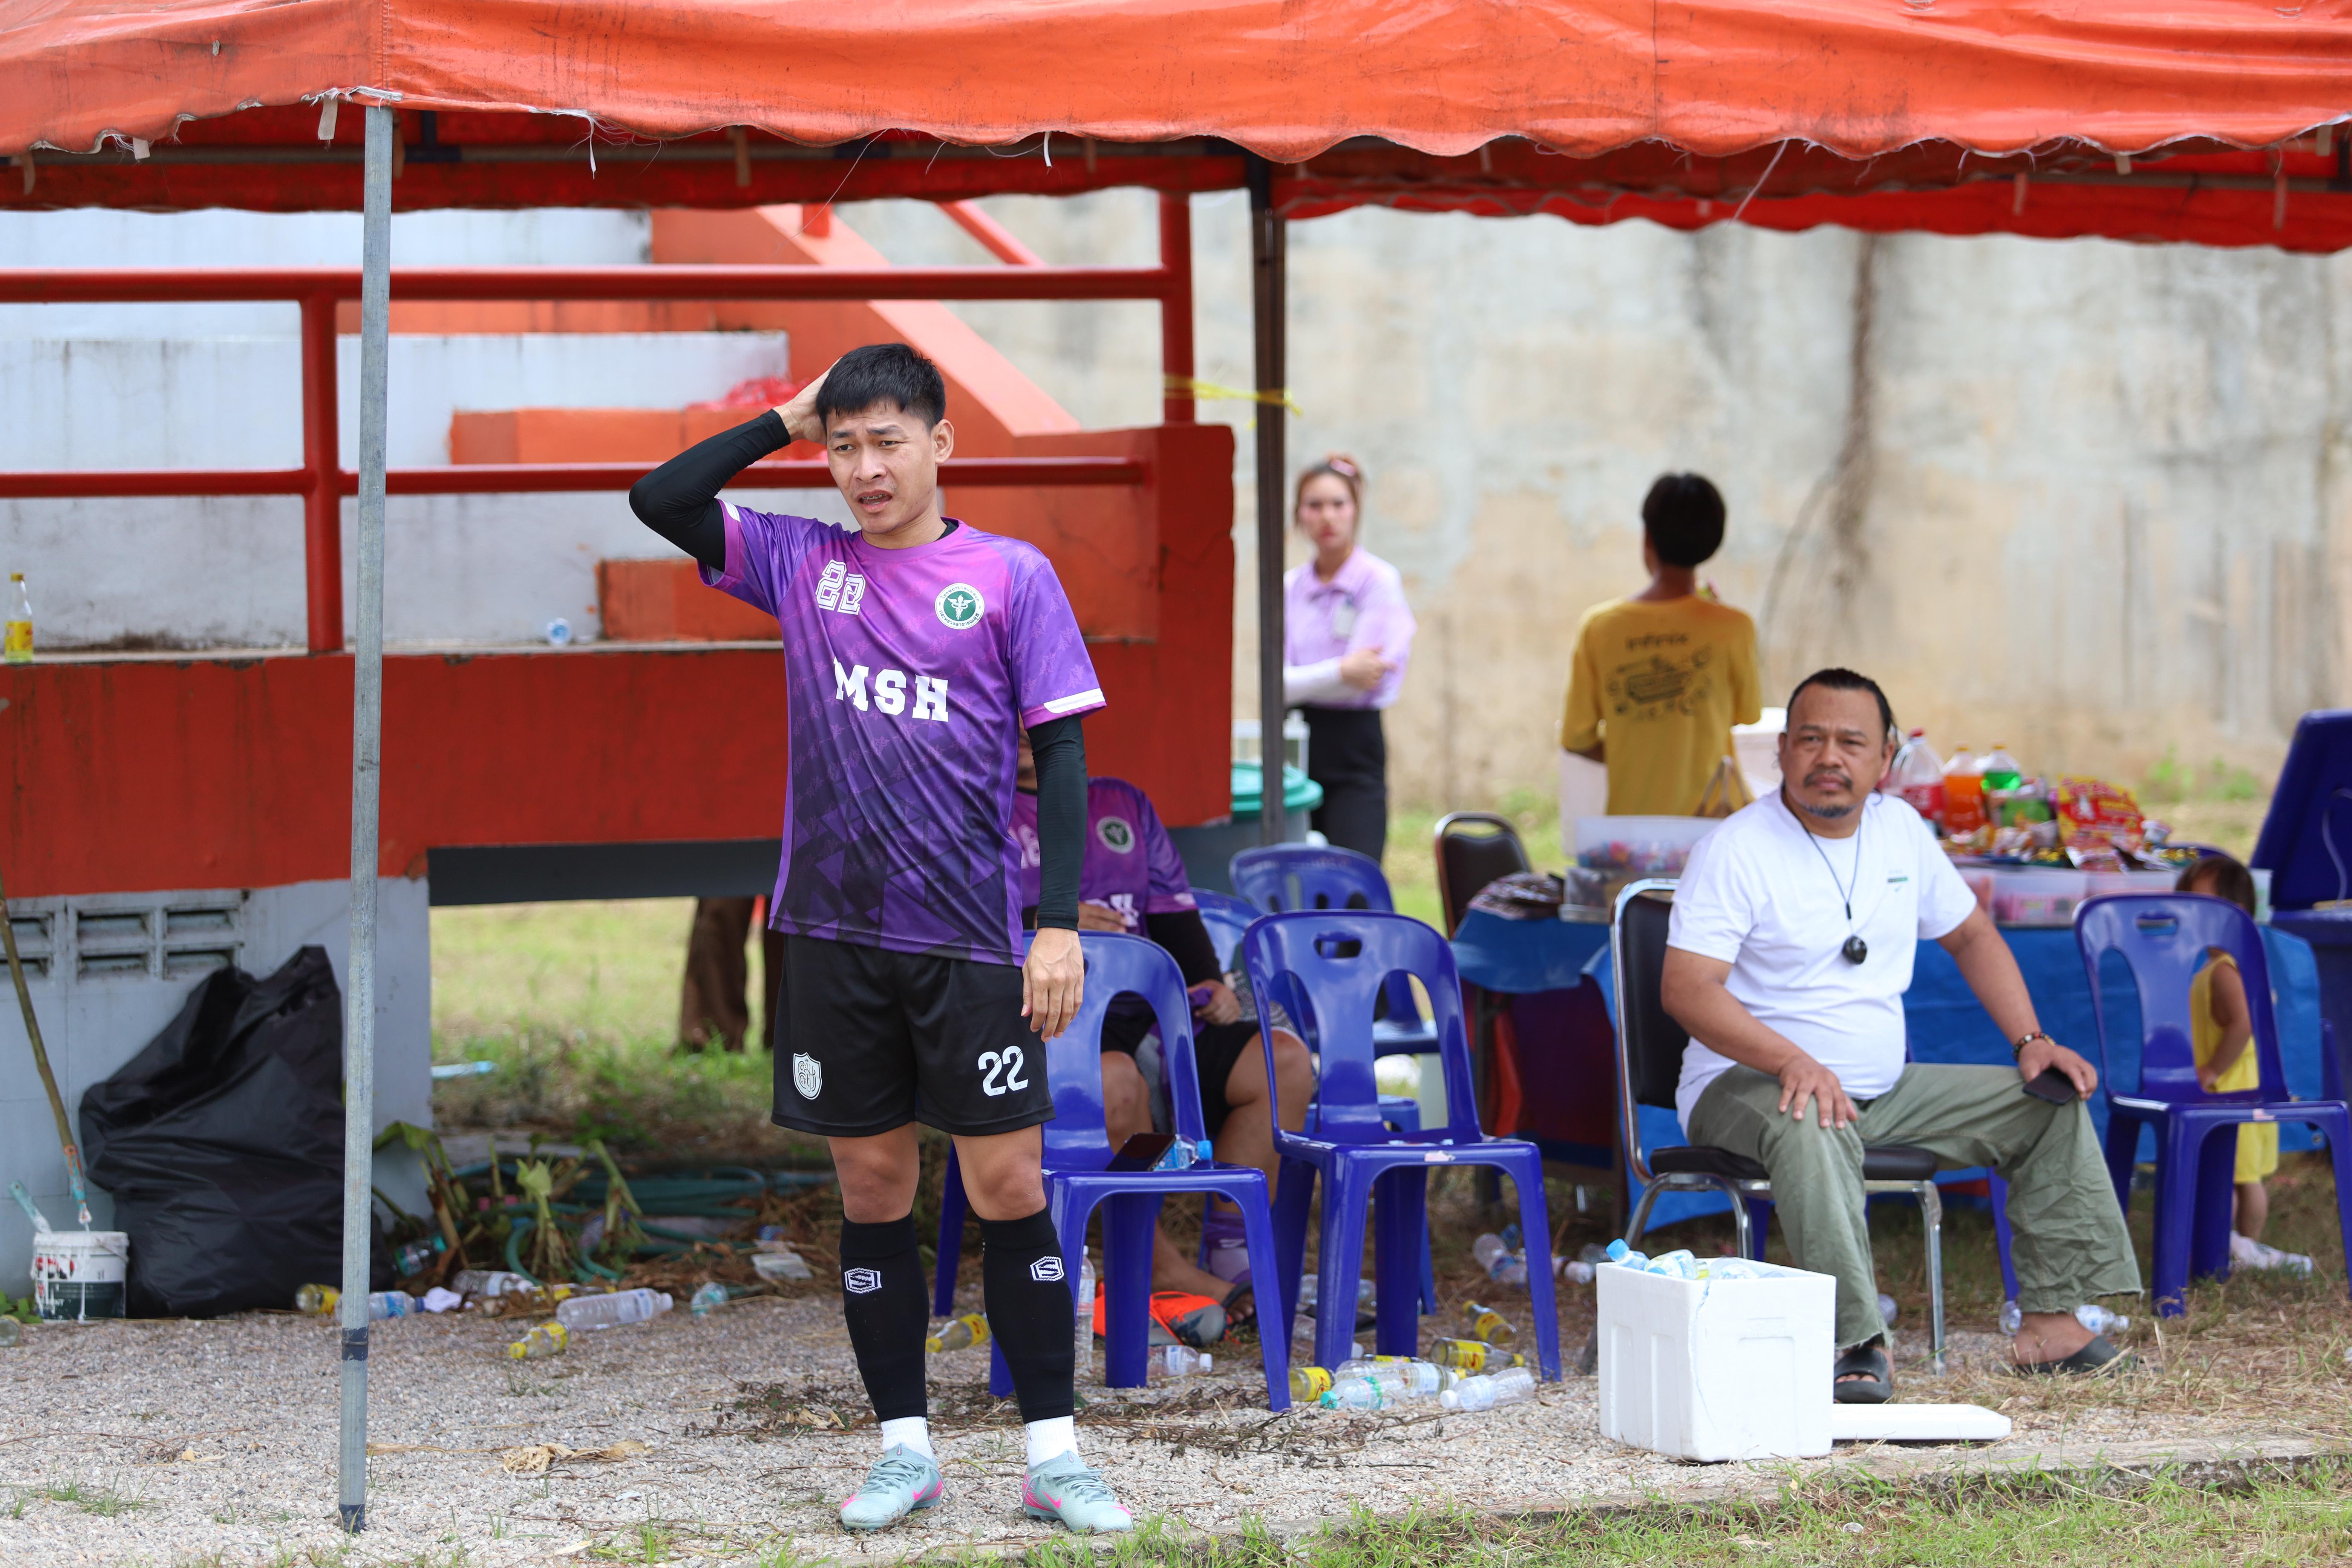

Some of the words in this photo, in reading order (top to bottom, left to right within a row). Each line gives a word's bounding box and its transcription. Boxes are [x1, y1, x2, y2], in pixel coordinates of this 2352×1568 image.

[815, 559, 866, 615] 22
[940, 586, 980, 602] โรงพยาบาลแม่สอด
[939, 610, 979, 626] กระทรวงสาธารณสุข
[833, 657, 949, 722] MSH
[978, 1045, 1028, 1096] 22
